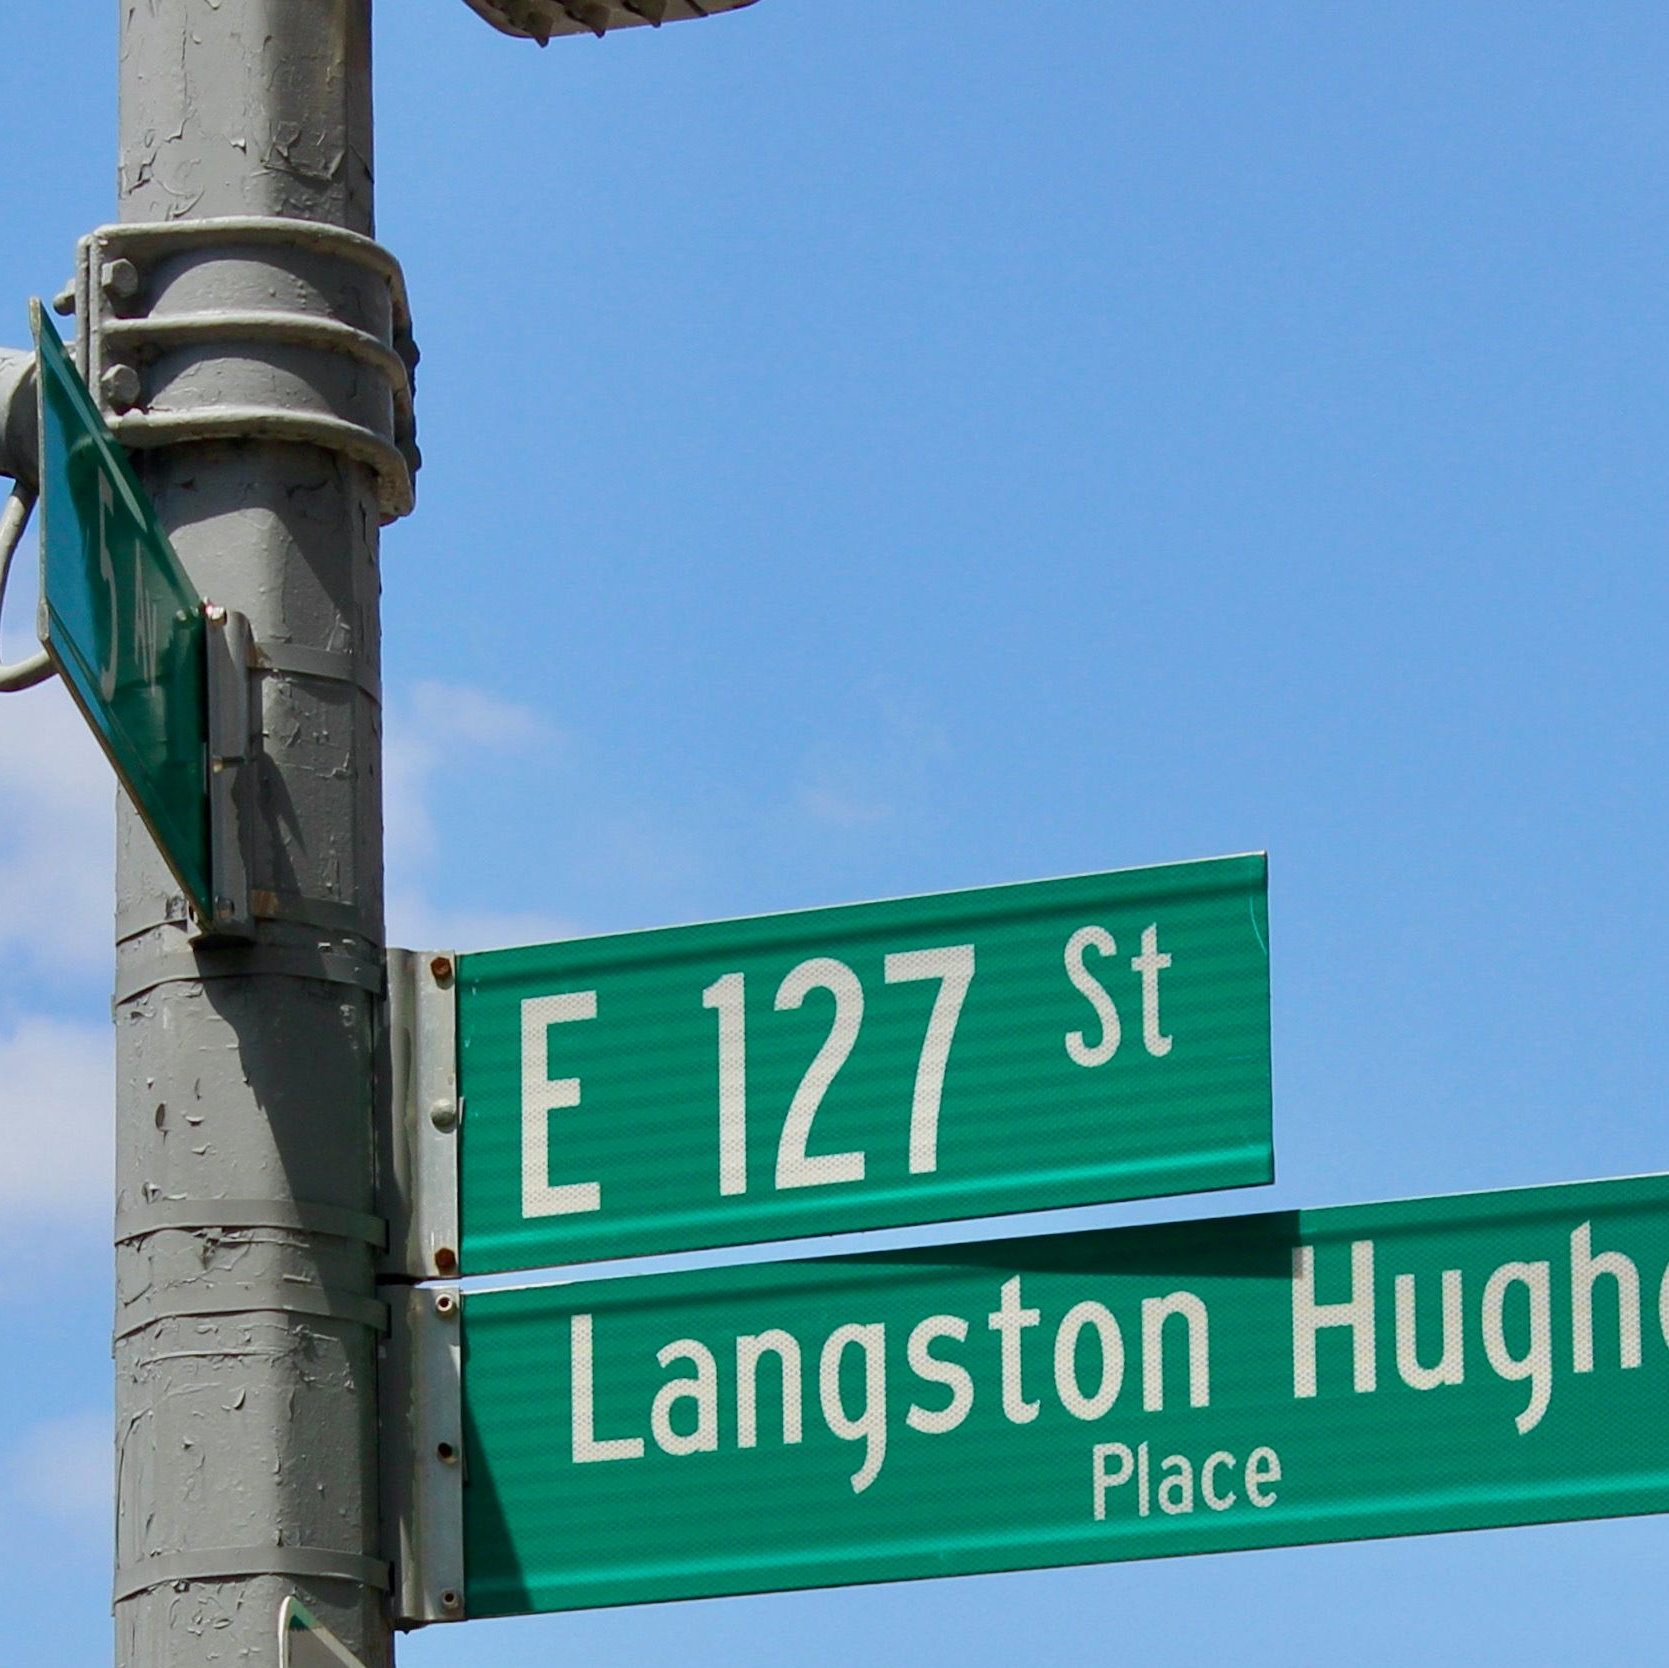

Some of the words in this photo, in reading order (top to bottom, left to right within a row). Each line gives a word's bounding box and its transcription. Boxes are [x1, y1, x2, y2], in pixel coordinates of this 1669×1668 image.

[98, 466, 118, 703] 5
[521, 990, 601, 1218] E
[702, 944, 976, 1195] 127
[1064, 925, 1173, 1068] St
[571, 1275, 1211, 1495] Langston
[1093, 1443, 1282, 1521] Place
